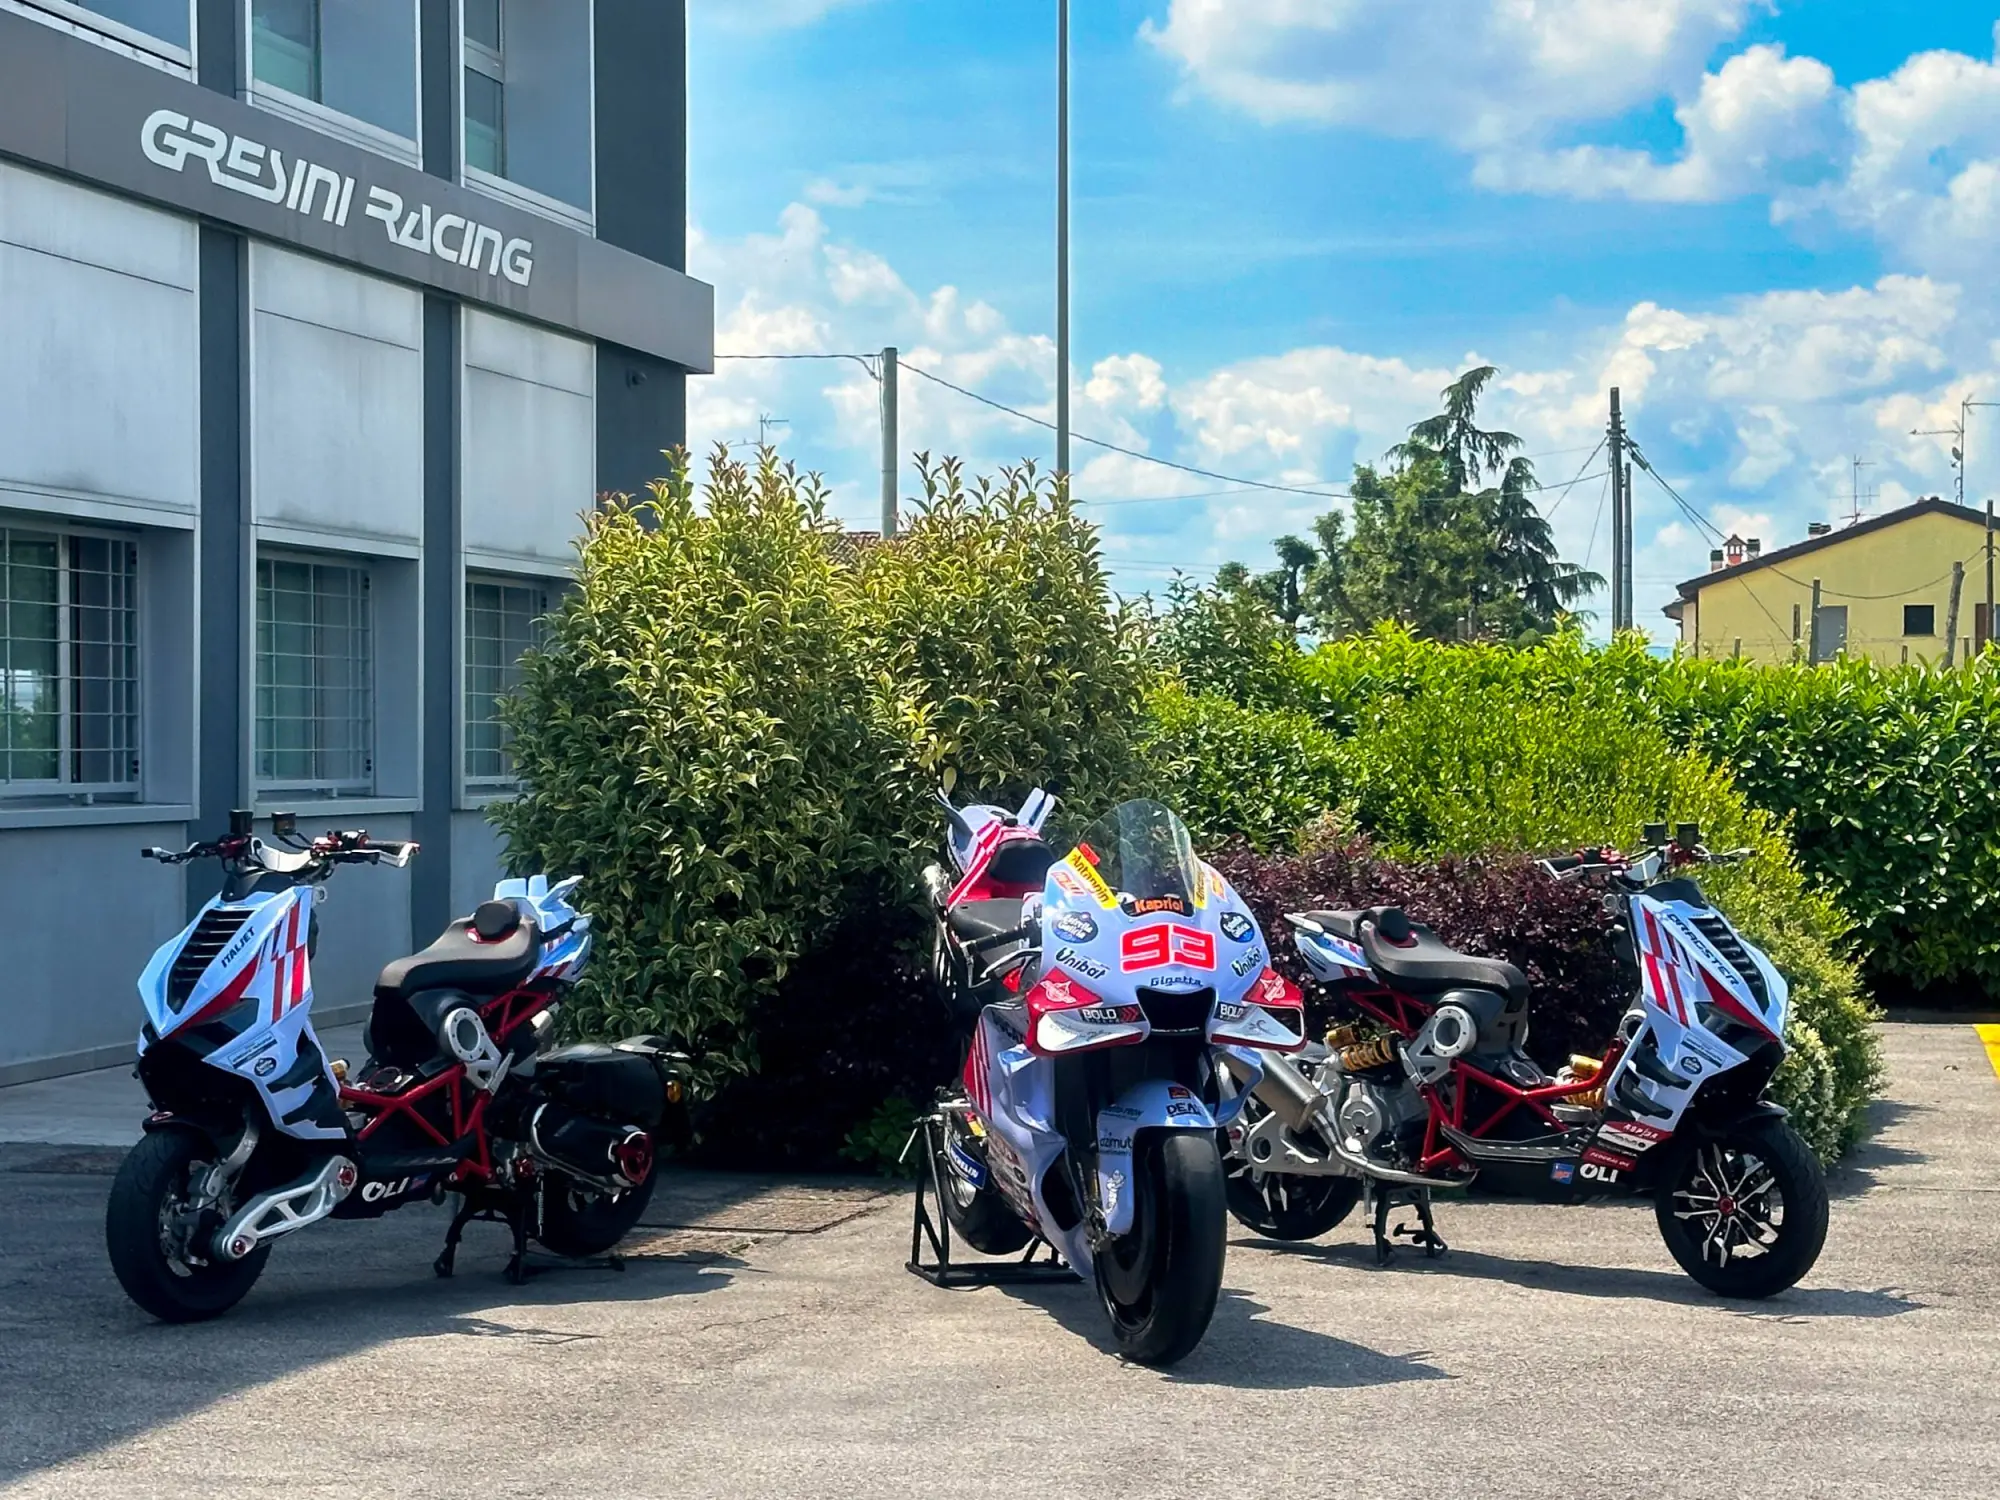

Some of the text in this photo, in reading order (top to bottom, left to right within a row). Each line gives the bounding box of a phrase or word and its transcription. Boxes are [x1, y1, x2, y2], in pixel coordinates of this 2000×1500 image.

[140, 109, 535, 287] GRESINI RACING
[1134, 898, 1184, 913] Kapriol
[221, 926, 255, 969] ITALJET
[1120, 922, 1217, 974] 93
[1667, 913, 1740, 986] DRAGSTER
[1082, 1008, 1118, 1021] BOLD
[361, 1176, 410, 1202] OLI
[1579, 1163, 1619, 1183] OLI
